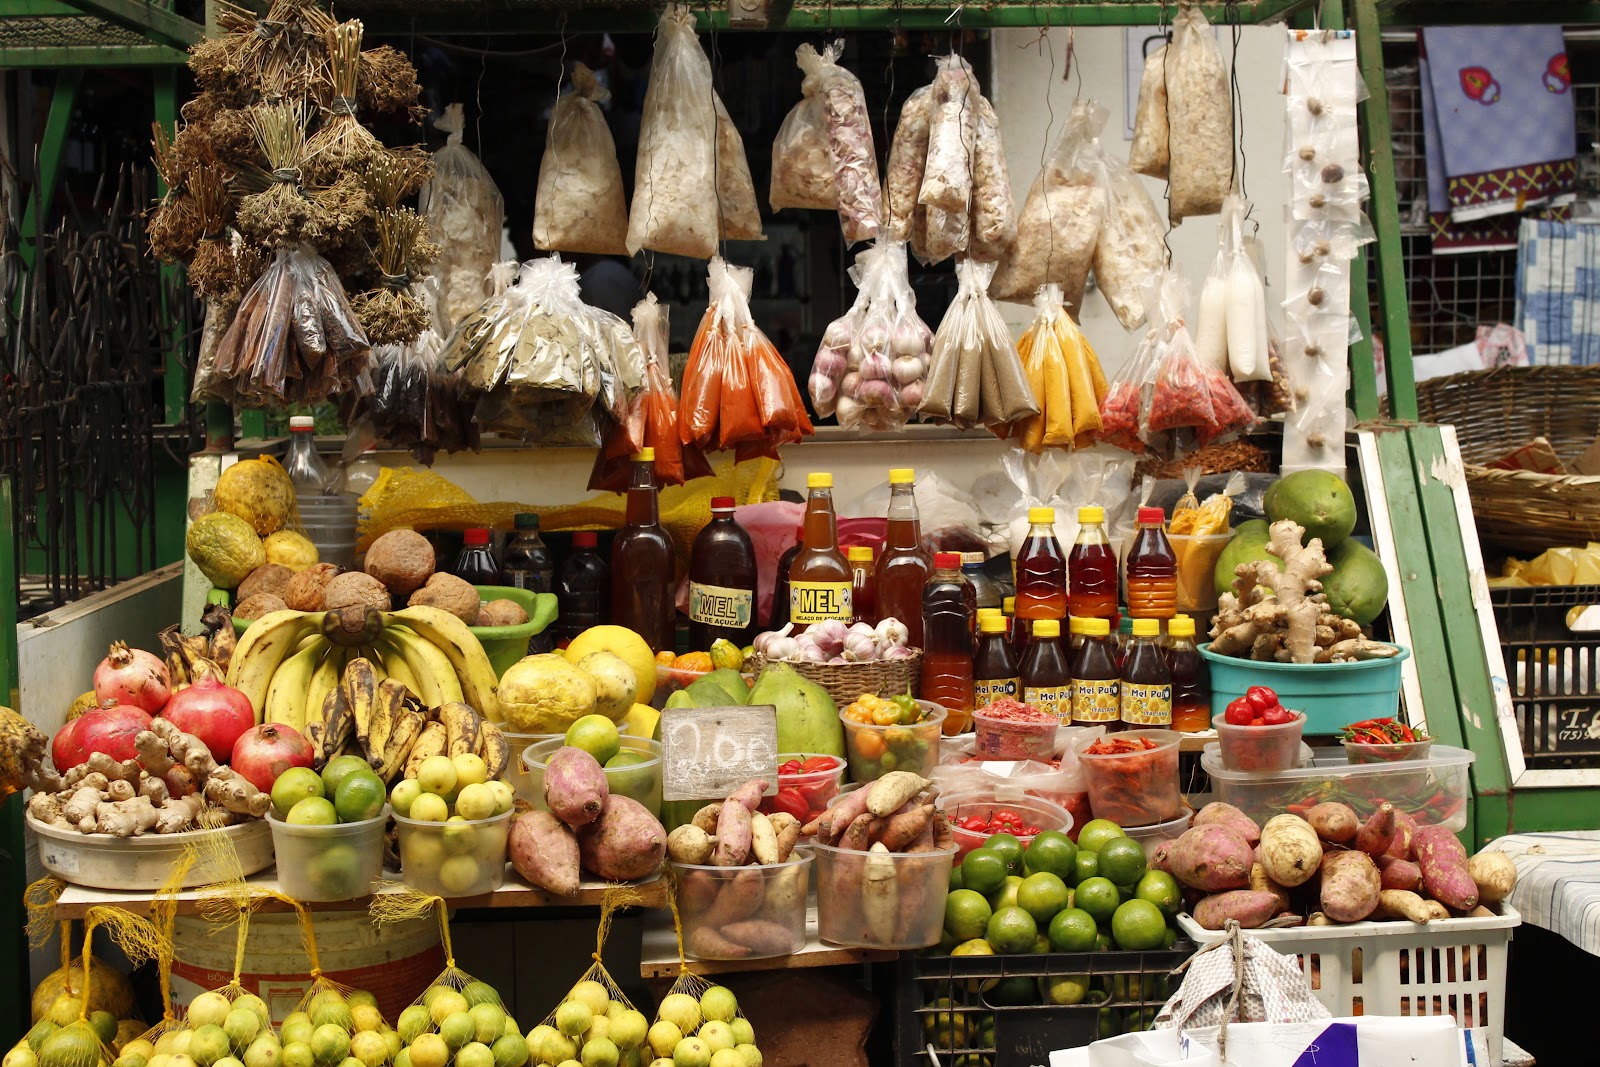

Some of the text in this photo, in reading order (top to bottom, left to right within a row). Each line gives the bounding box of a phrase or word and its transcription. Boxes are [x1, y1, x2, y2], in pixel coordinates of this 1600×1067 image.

[801, 589, 839, 613] MEL
[700, 594, 737, 618] MEL
[693, 614, 703, 622] MEL
[975, 685, 989, 694] Mel
[1079, 686, 1094, 694] Mel
[1131, 689, 1147, 698] Mel
[1040, 693, 1056, 701] Mel
